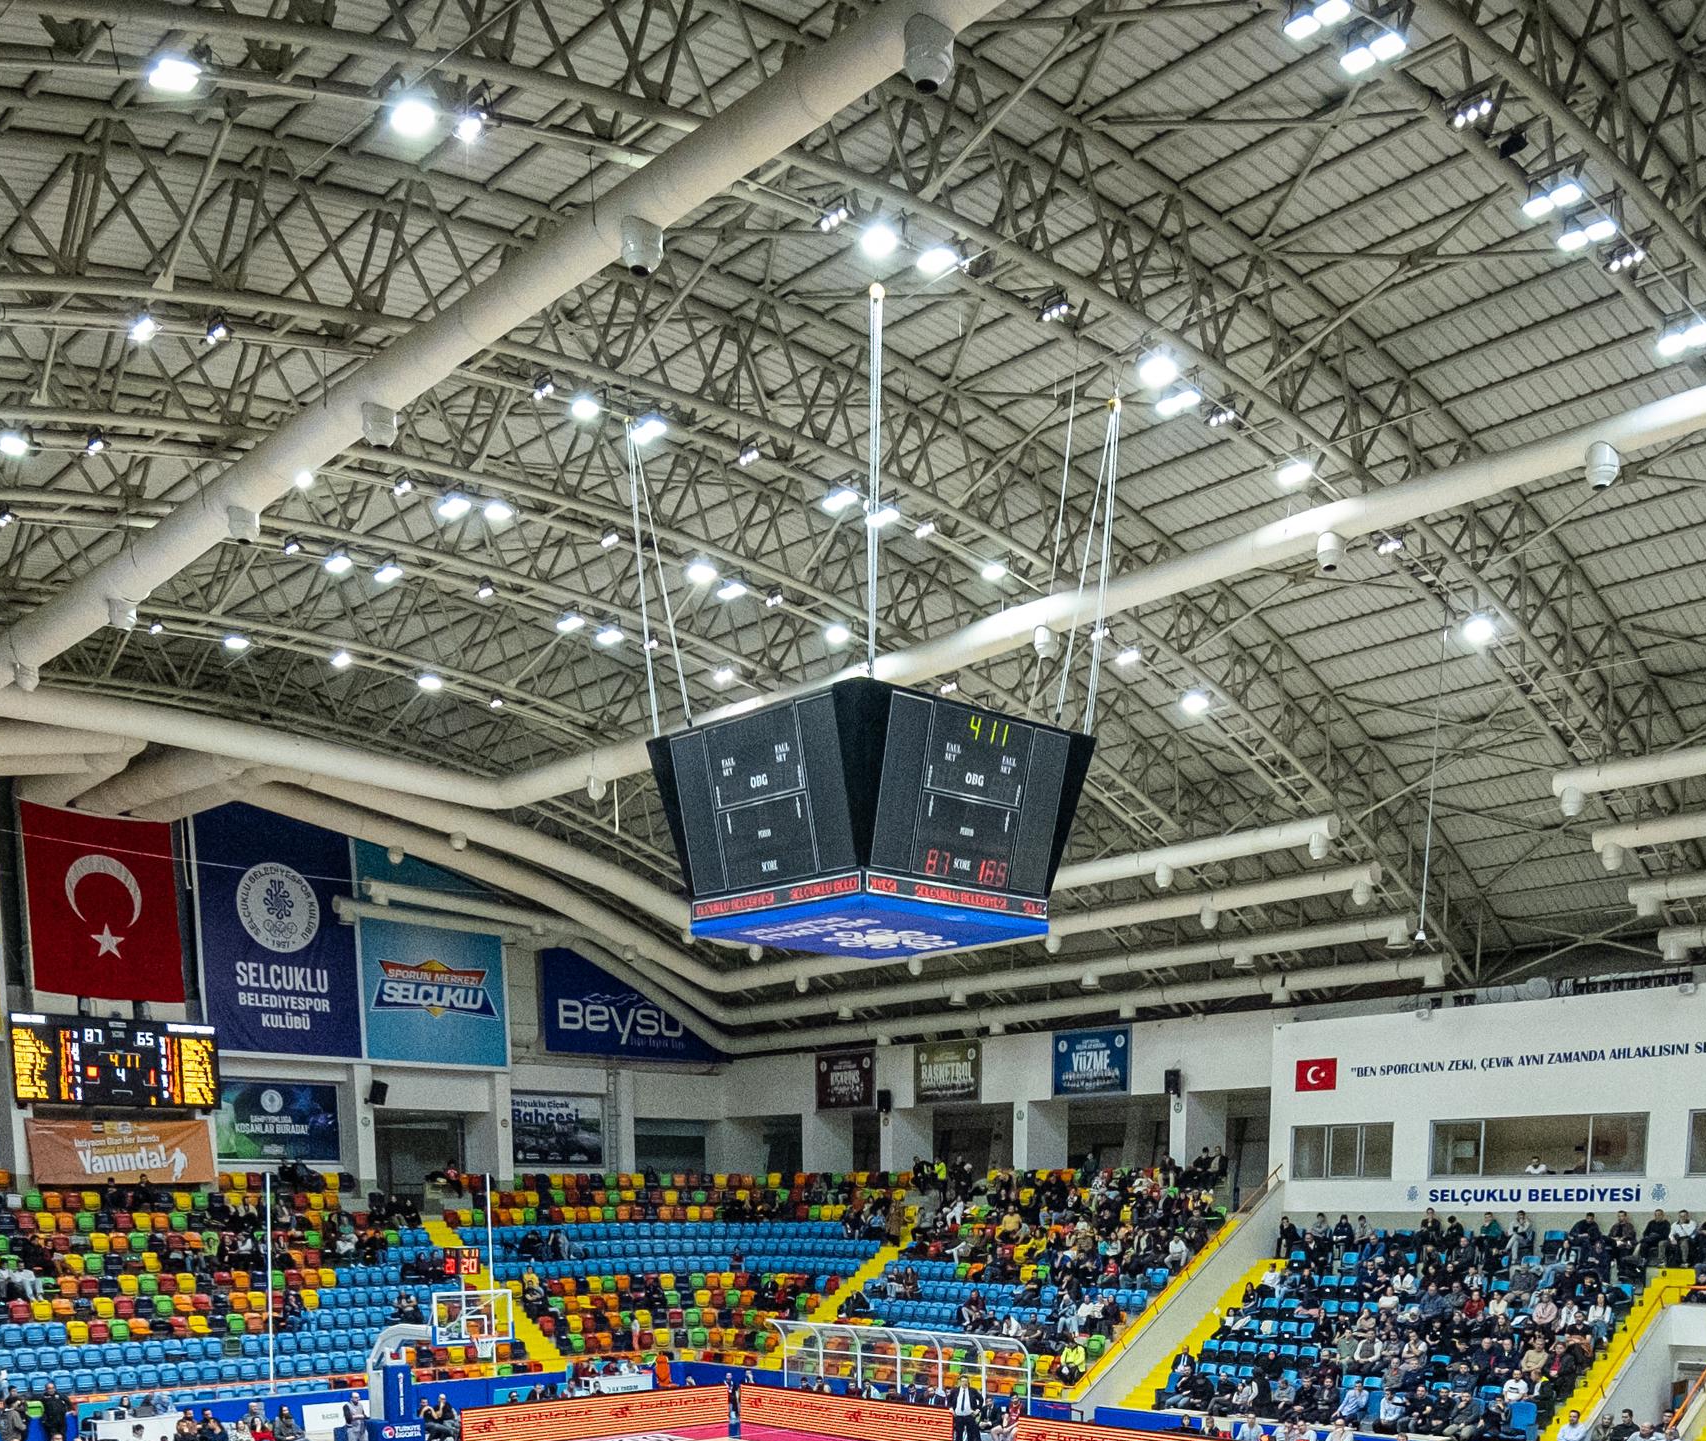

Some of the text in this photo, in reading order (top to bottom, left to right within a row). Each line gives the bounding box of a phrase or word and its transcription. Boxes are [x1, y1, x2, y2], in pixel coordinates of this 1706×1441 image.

[969, 715, 981, 740] 4
[236, 960, 329, 994] SELÇUKLU
[388, 968, 480, 987] SPORUN MERKEZİ
[238, 992, 330, 1012] BELEDİYESPOR
[383, 983, 483, 1010] SELÇUKLU
[261, 1012, 311, 1030] KULÜBÜ
[84, 1029, 102, 1042] 87
[136, 1032, 154, 1046] 65
[1071, 1050, 1110, 1072] YÜZME
[1379, 1061, 1444, 1076] SPORCUNUN
[1518, 1054, 1544, 1066] AYNI
[1547, 1050, 1606, 1064] ZAMANDA
[1609, 1043, 1690, 1061] AHLAKLISINI
[116, 1068, 126, 1082] 4
[78, 1144, 168, 1174] Yanında!
[1428, 1184, 1641, 1206] SELÇUKLU BELEDİYESİ
[460, 1258, 477, 1274] 20
